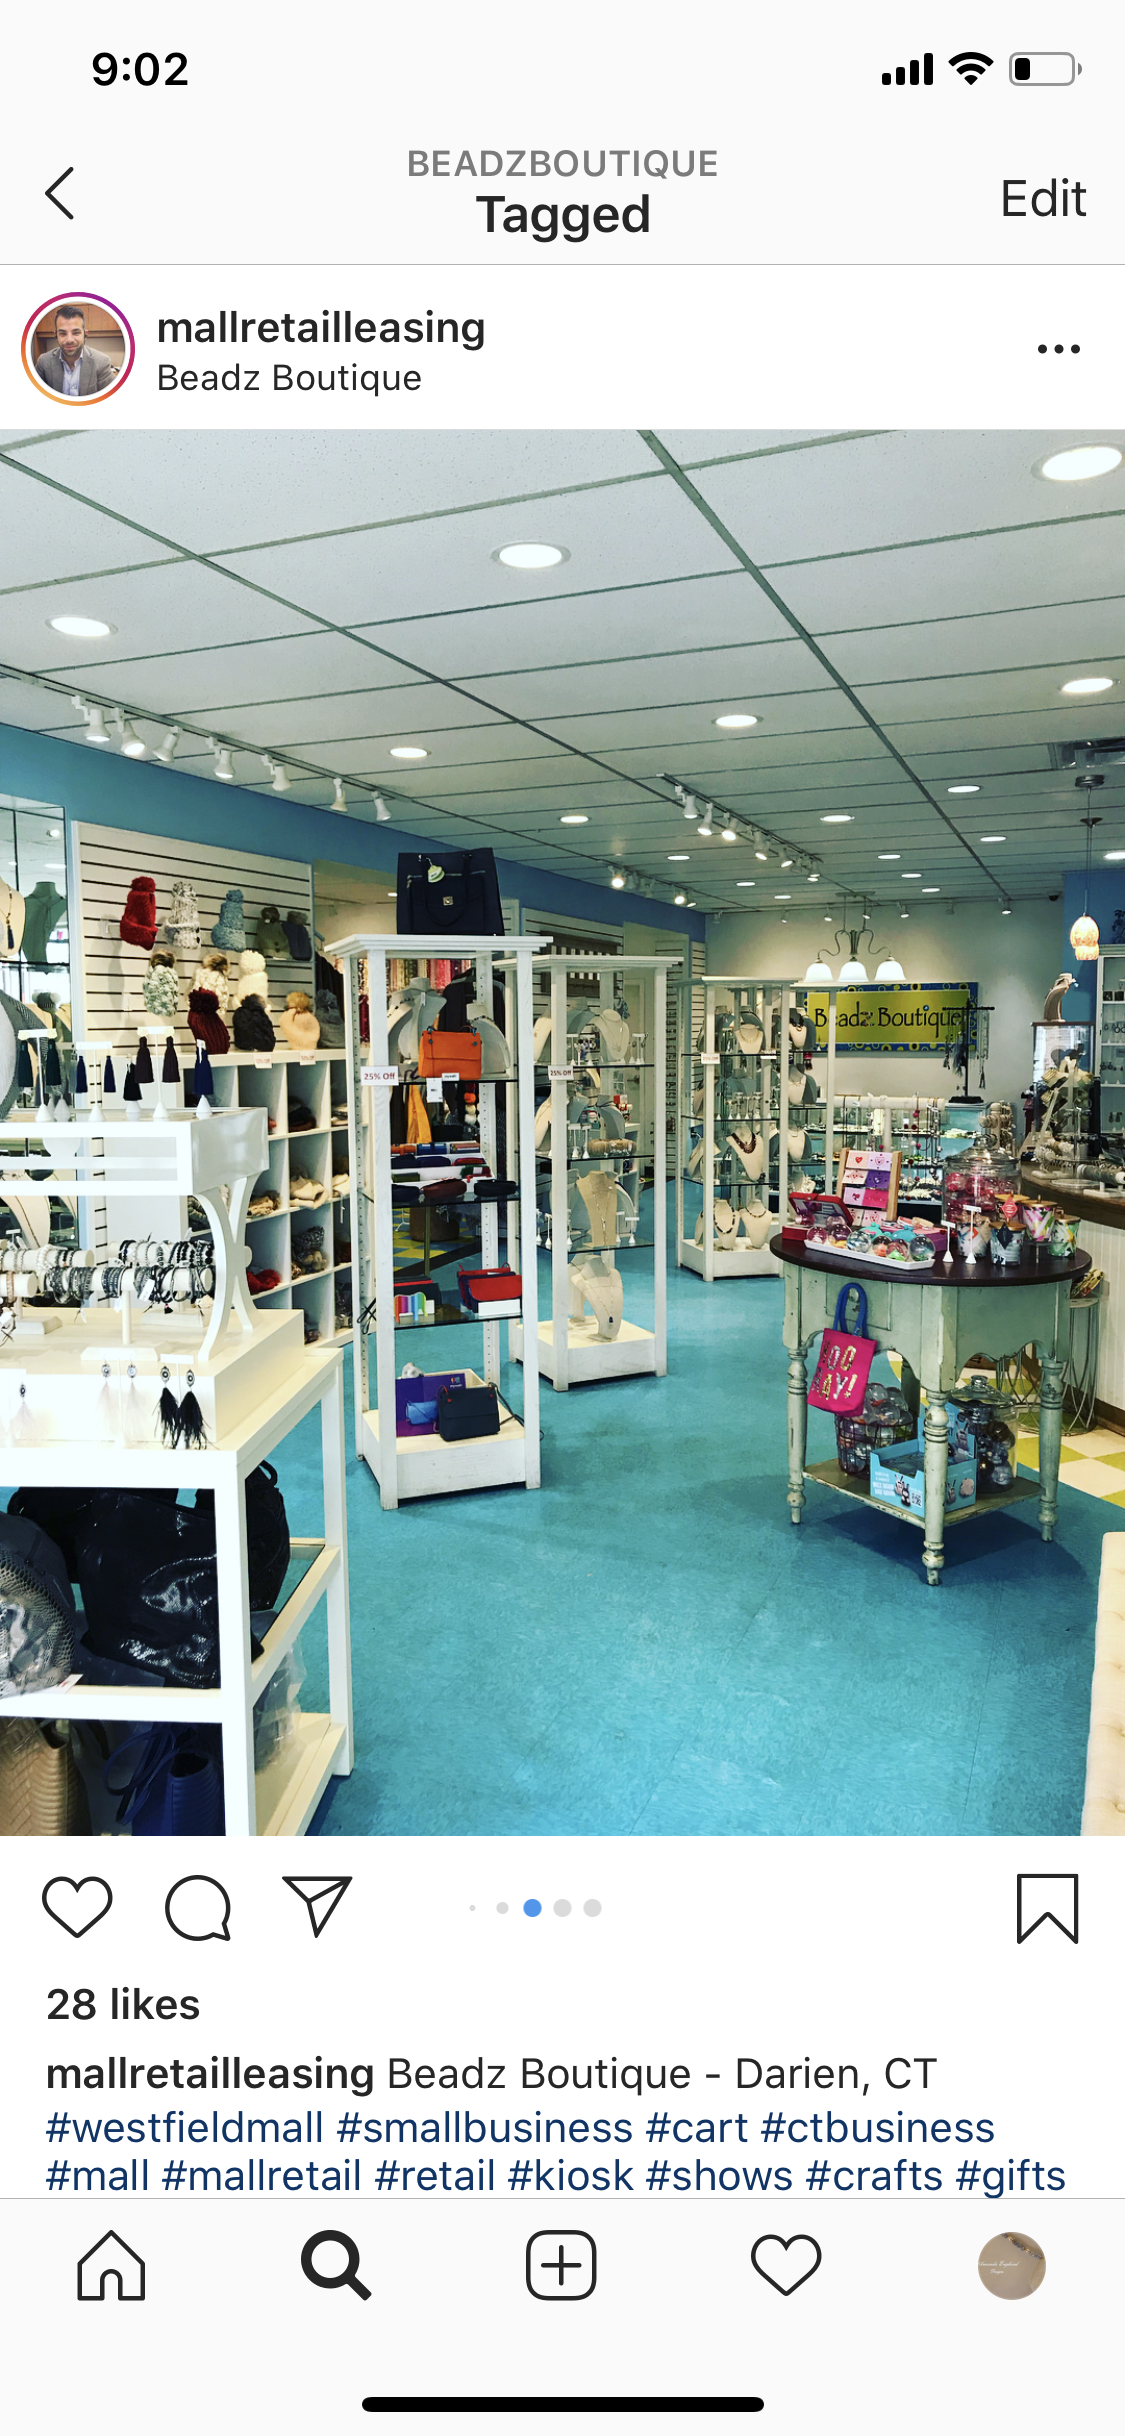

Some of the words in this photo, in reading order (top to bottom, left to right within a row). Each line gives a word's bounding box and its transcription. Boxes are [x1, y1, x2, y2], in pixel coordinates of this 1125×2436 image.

[815, 1001, 874, 1027] Badz
[878, 1005, 961, 1038] Boutique
[364, 1073, 381, 1081] 25%
[383, 1072, 396, 1080] Off
[550, 1069, 562, 1077] 25%
